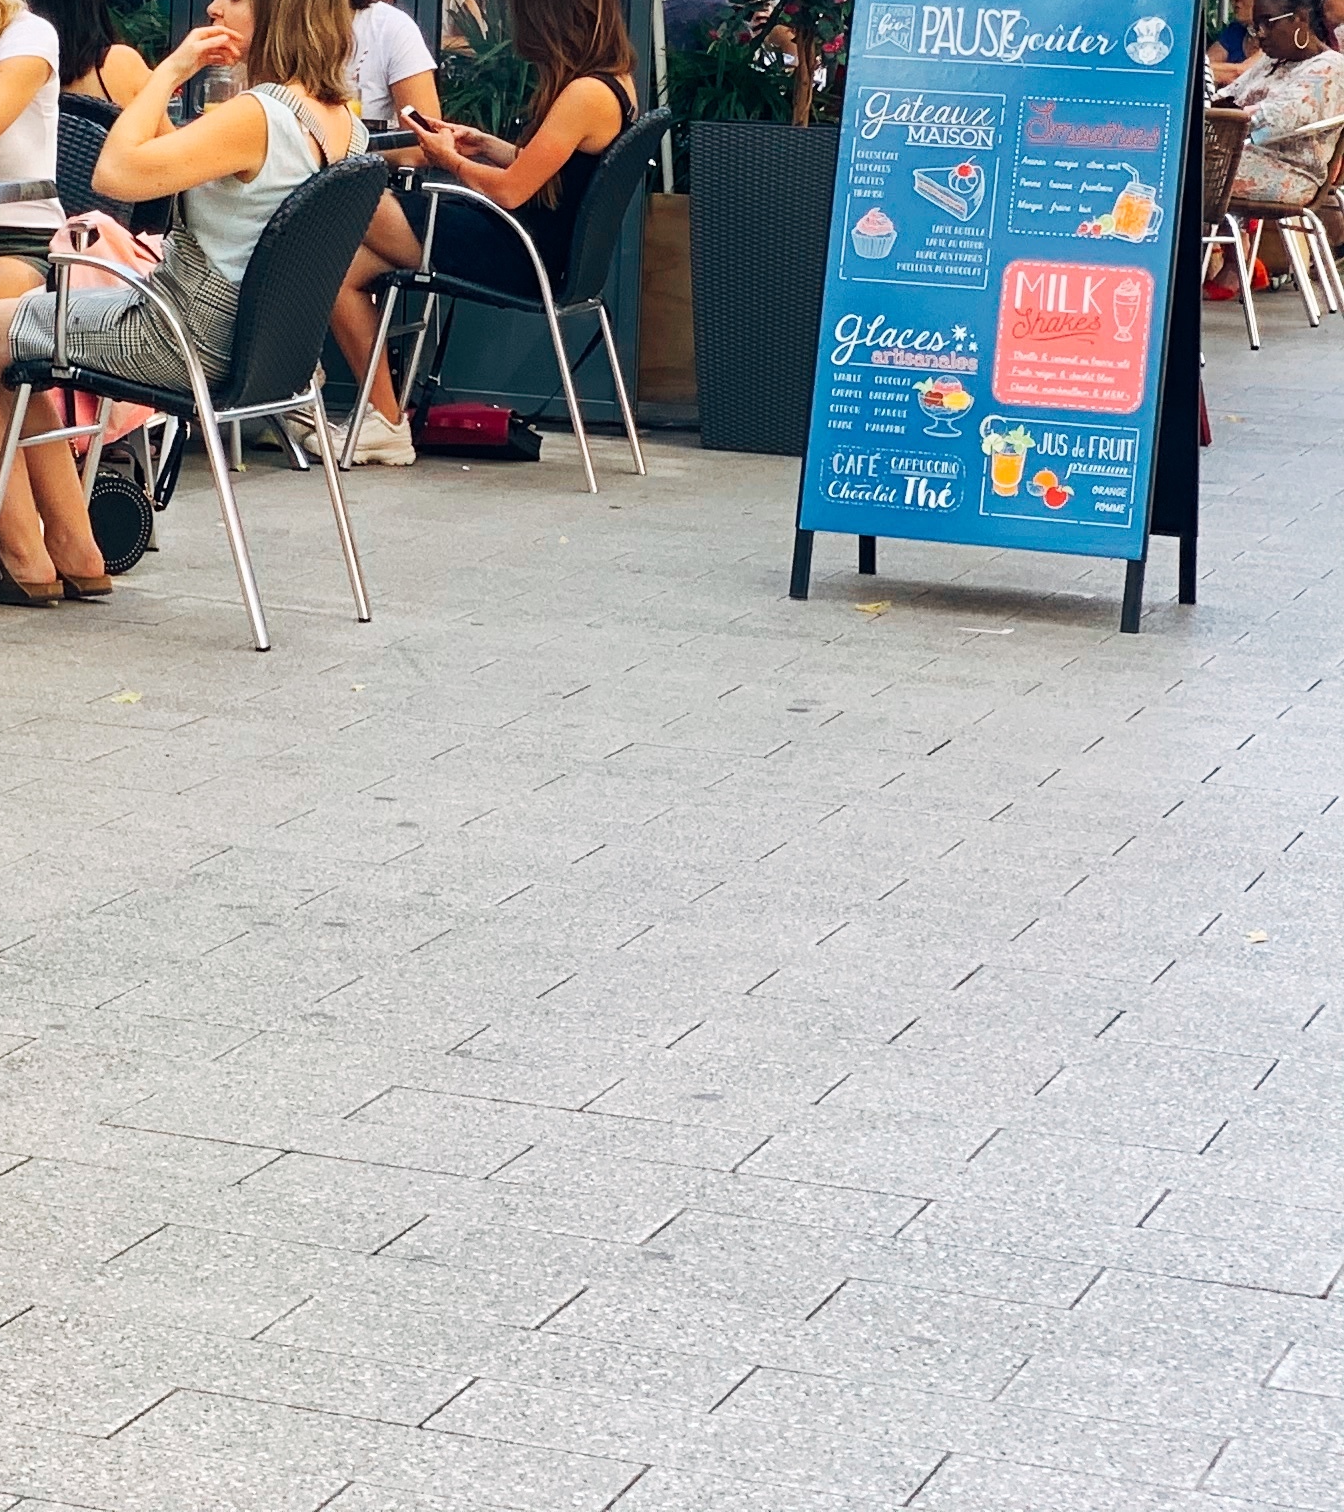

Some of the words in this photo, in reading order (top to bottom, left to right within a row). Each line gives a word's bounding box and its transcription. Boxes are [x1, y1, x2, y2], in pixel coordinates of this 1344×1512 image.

[918, 5, 1021, 58] PAUSE
[907, 125, 995, 147] MAISON
[1014, 271, 1106, 315] MILK
[1012, 308, 1102, 339] Shakes
[871, 348, 979, 371] artisanales
[1036, 431, 1069, 457] JUS
[1071, 434, 1086, 458] de
[1087, 435, 1136, 462] FRUIT
[832, 451, 882, 478] CAFÉ
[890, 456, 960, 475] CAPPUCCINO
[903, 476, 956, 509] Thé
[1091, 485, 1128, 498] ORANGE
[1094, 501, 1127, 514] POMME
